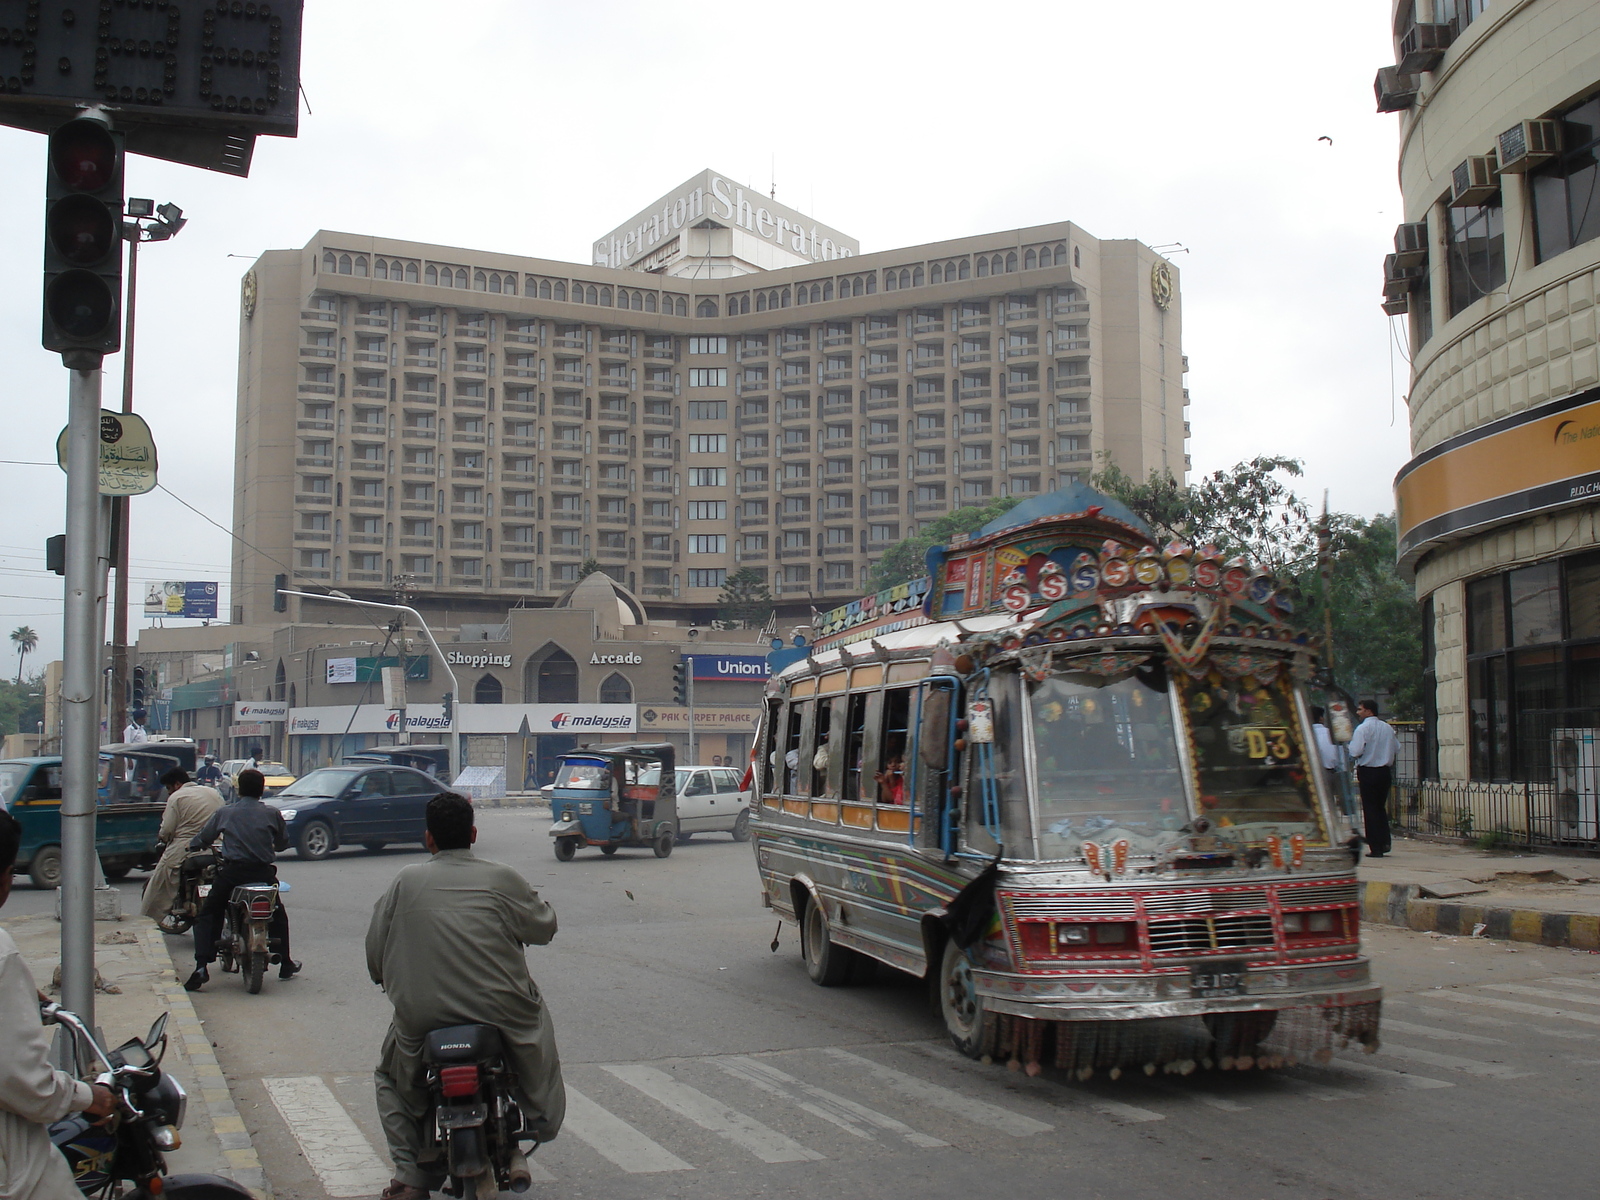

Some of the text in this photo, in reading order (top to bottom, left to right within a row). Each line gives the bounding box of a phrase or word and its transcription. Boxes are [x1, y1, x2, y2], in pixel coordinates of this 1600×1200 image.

[711, 176, 854, 261] Sheraton
[594, 187, 704, 269] Sheraton
[1563, 432, 1578, 445] The
[447, 651, 511, 668] Shopping
[590, 652, 642, 664] Arcade
[718, 660, 760, 674] Union
[297, 718, 319, 729] malaysia
[405, 715, 451, 729] malaysia
[572, 715, 632, 728] malaysia
[661, 713, 679, 721] PAK
[720, 714, 751, 722] PALACE
